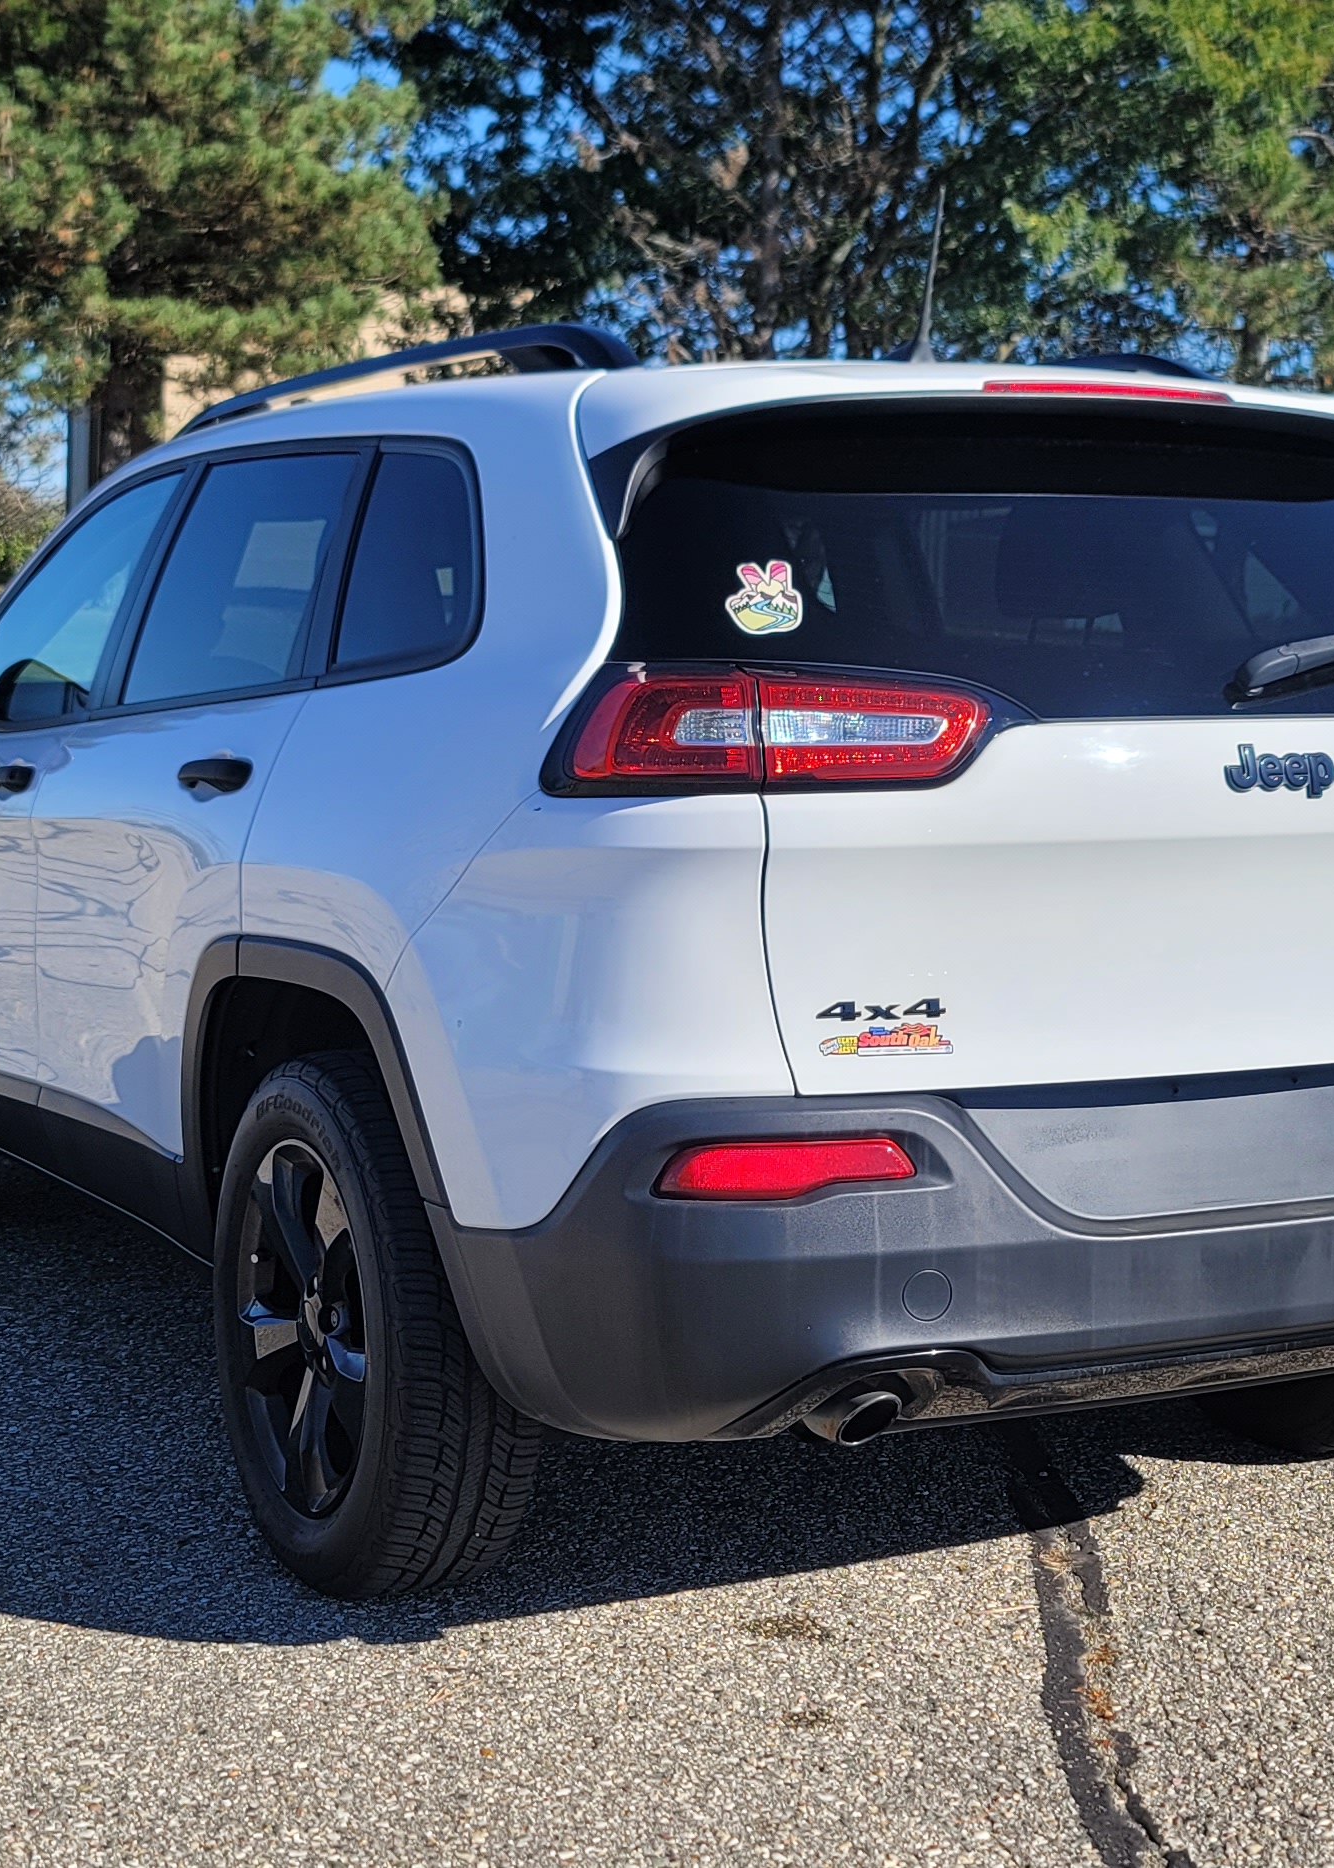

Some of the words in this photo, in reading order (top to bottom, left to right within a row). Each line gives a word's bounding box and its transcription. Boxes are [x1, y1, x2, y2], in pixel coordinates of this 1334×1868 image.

[816, 997, 946, 1022] 4x4
[858, 1031, 908, 1047] South
[909, 1025, 941, 1048] Oak
[256, 1094, 341, 1172] BFGoodrich
